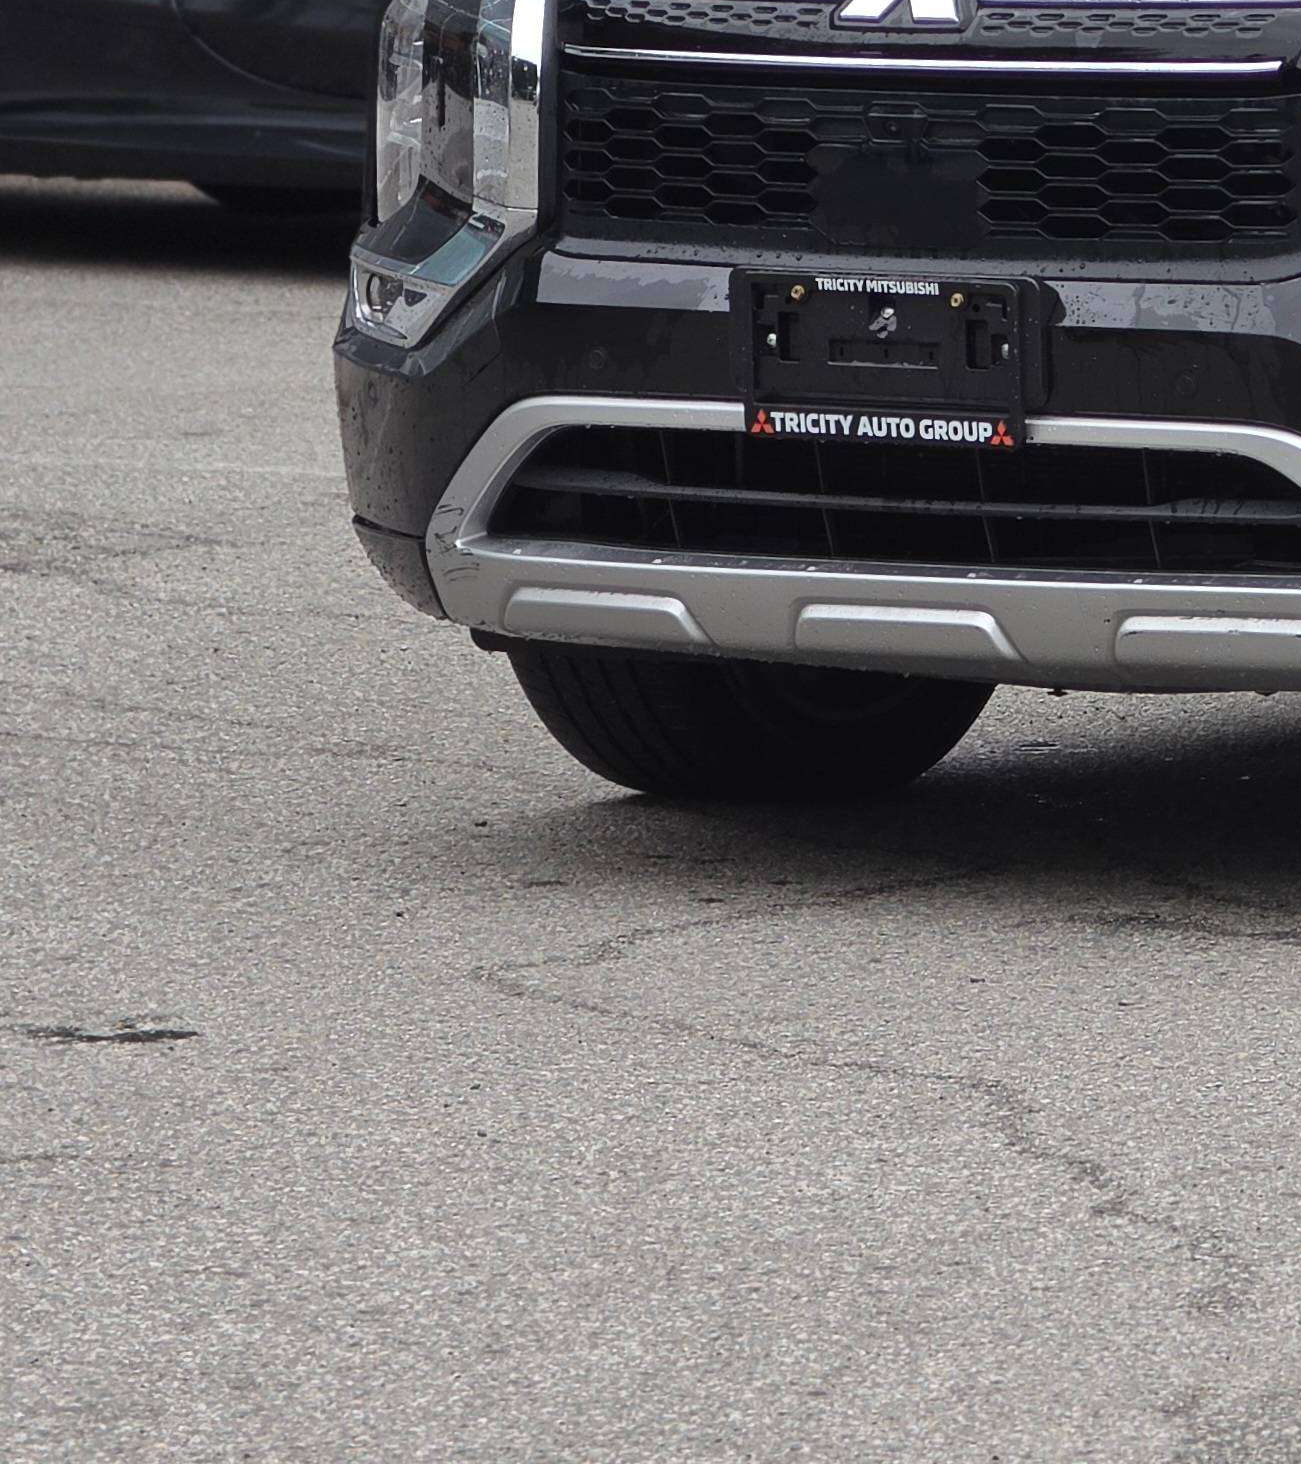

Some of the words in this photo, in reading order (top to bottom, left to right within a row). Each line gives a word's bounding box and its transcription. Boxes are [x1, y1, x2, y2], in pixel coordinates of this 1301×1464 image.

[815, 277, 864, 293] TRICITY
[865, 279, 940, 296] MITSUBISHI
[770, 411, 854, 437] TRICITY
[857, 416, 915, 438] AUTO
[919, 419, 993, 443] GROUP
